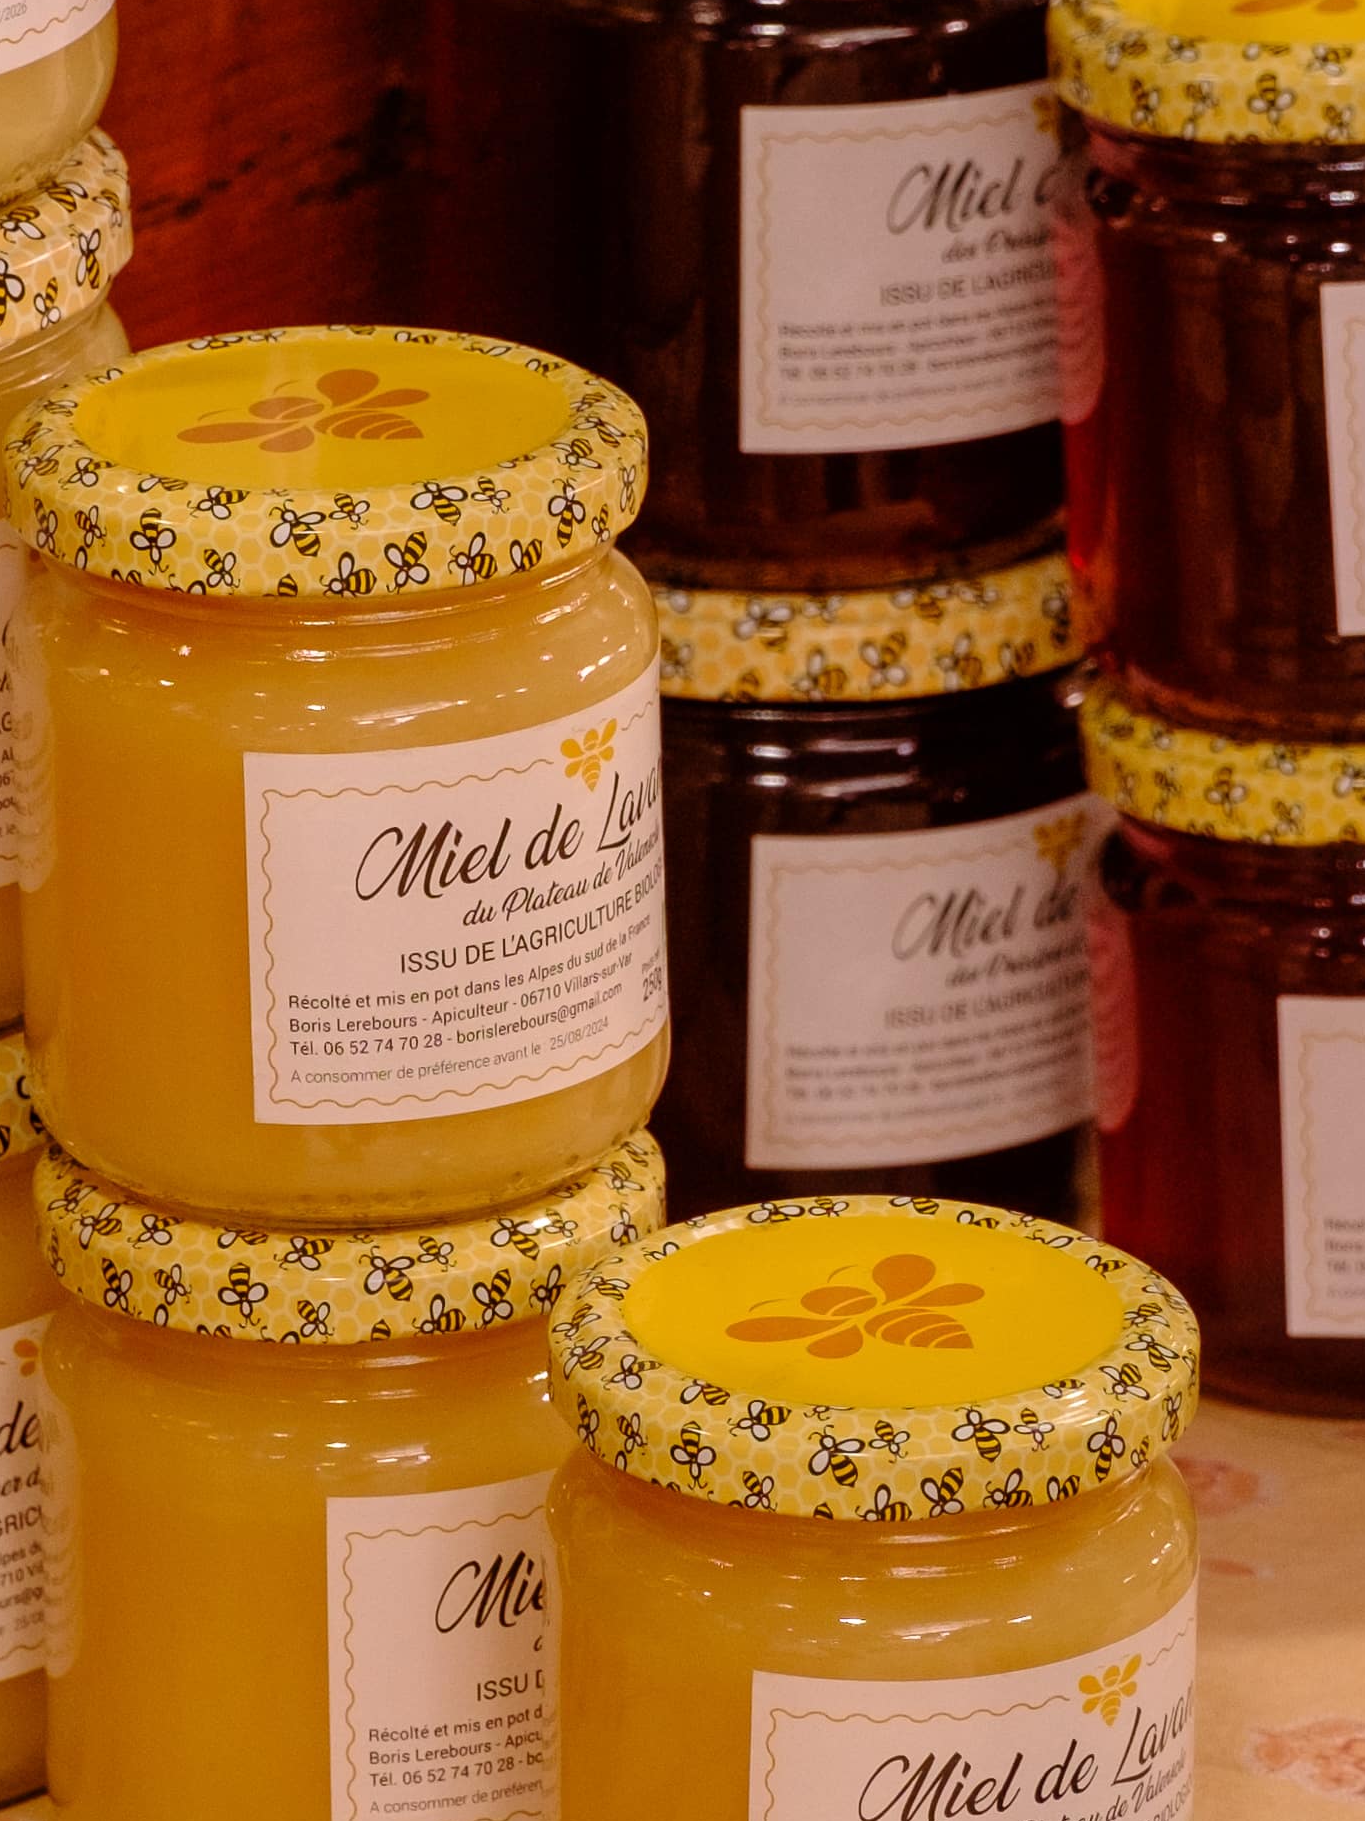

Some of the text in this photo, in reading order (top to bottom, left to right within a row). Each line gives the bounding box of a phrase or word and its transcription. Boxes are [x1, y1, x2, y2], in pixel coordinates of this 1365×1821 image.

[355, 762, 659, 901] Miel de Lava
[400, 888, 633, 974] ISSU DE L'AGRICULTURE
[462, 866, 612, 927] du Plateau de
[434, 1550, 545, 1634] Mie
[476, 1672, 529, 1702] ISSU
[1034, 1738, 1099, 1804] de
